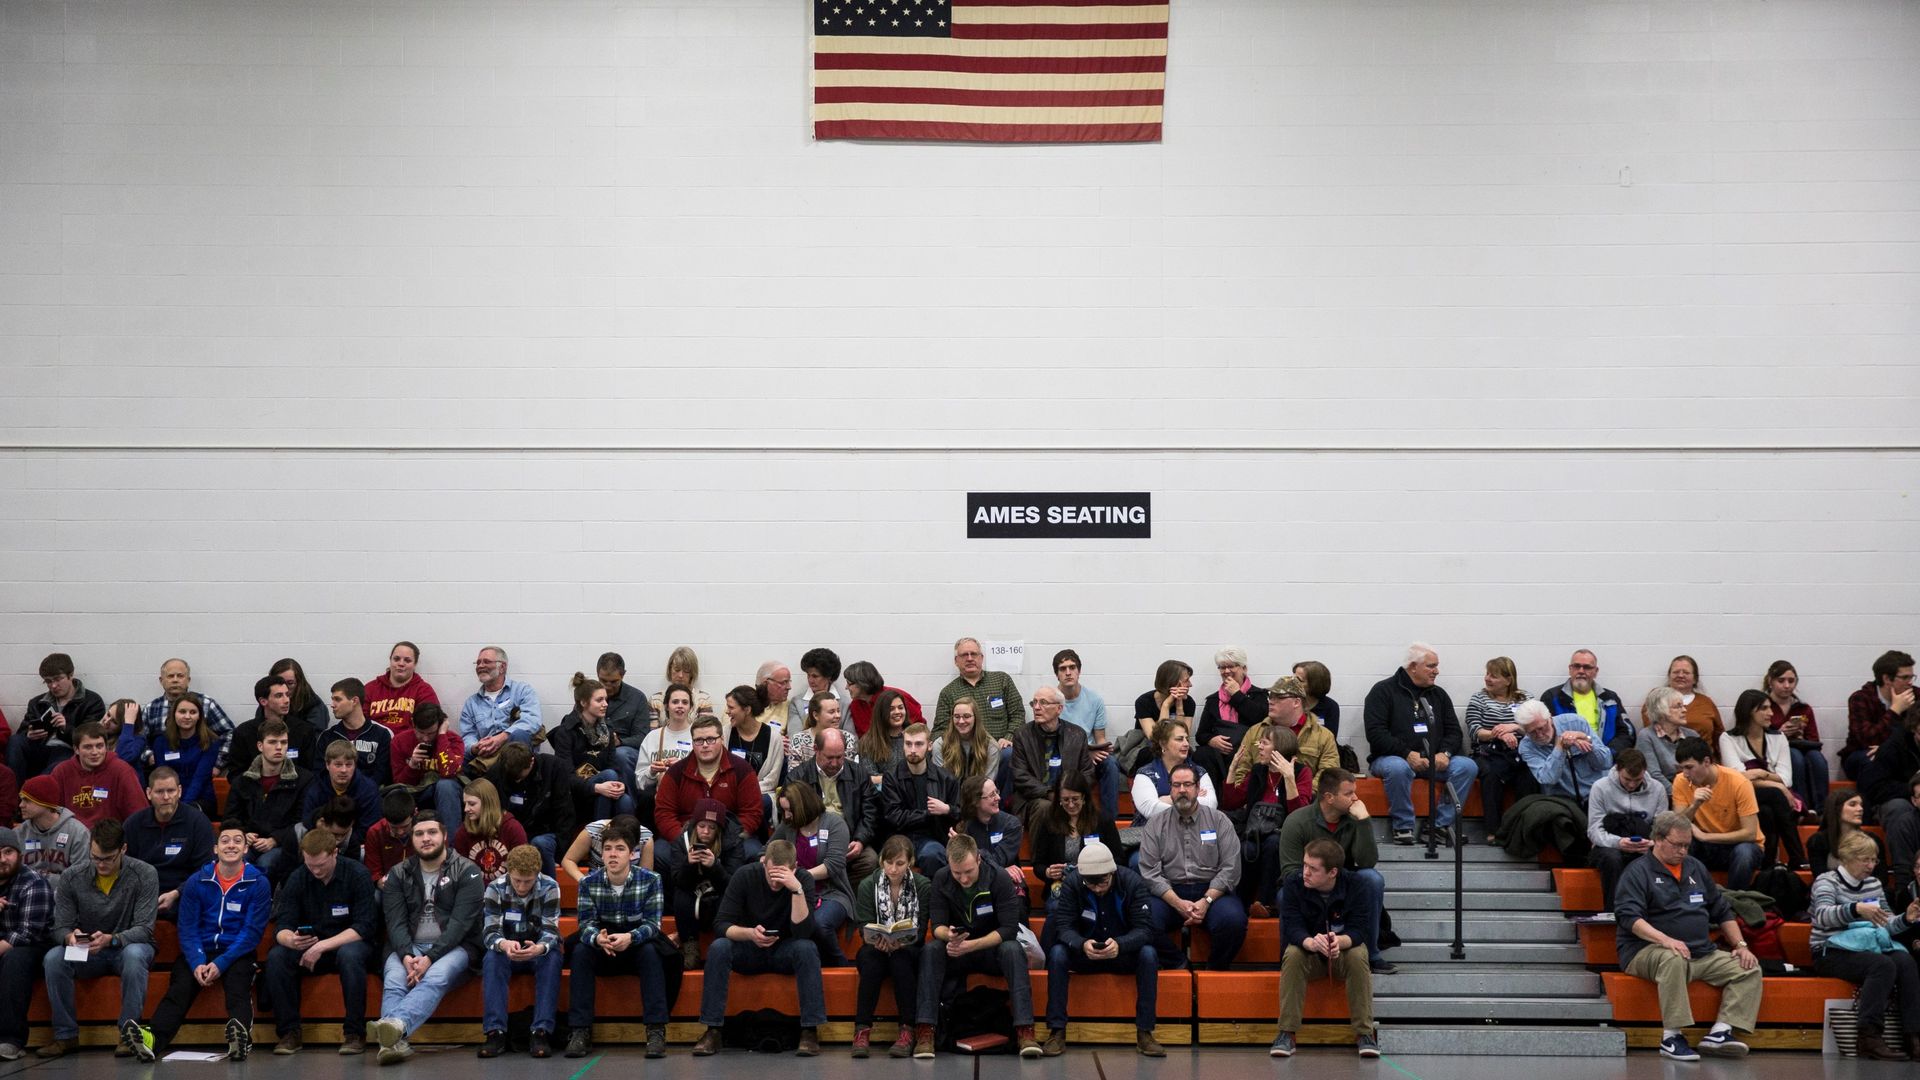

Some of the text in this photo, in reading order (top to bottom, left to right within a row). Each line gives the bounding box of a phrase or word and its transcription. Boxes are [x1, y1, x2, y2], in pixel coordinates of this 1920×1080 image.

[974, 506, 1146, 524] AMES SEATING
[991, 646, 1024, 655] 138-160
[72, 792, 102, 805] STA
[24, 848, 69, 868] OWA
